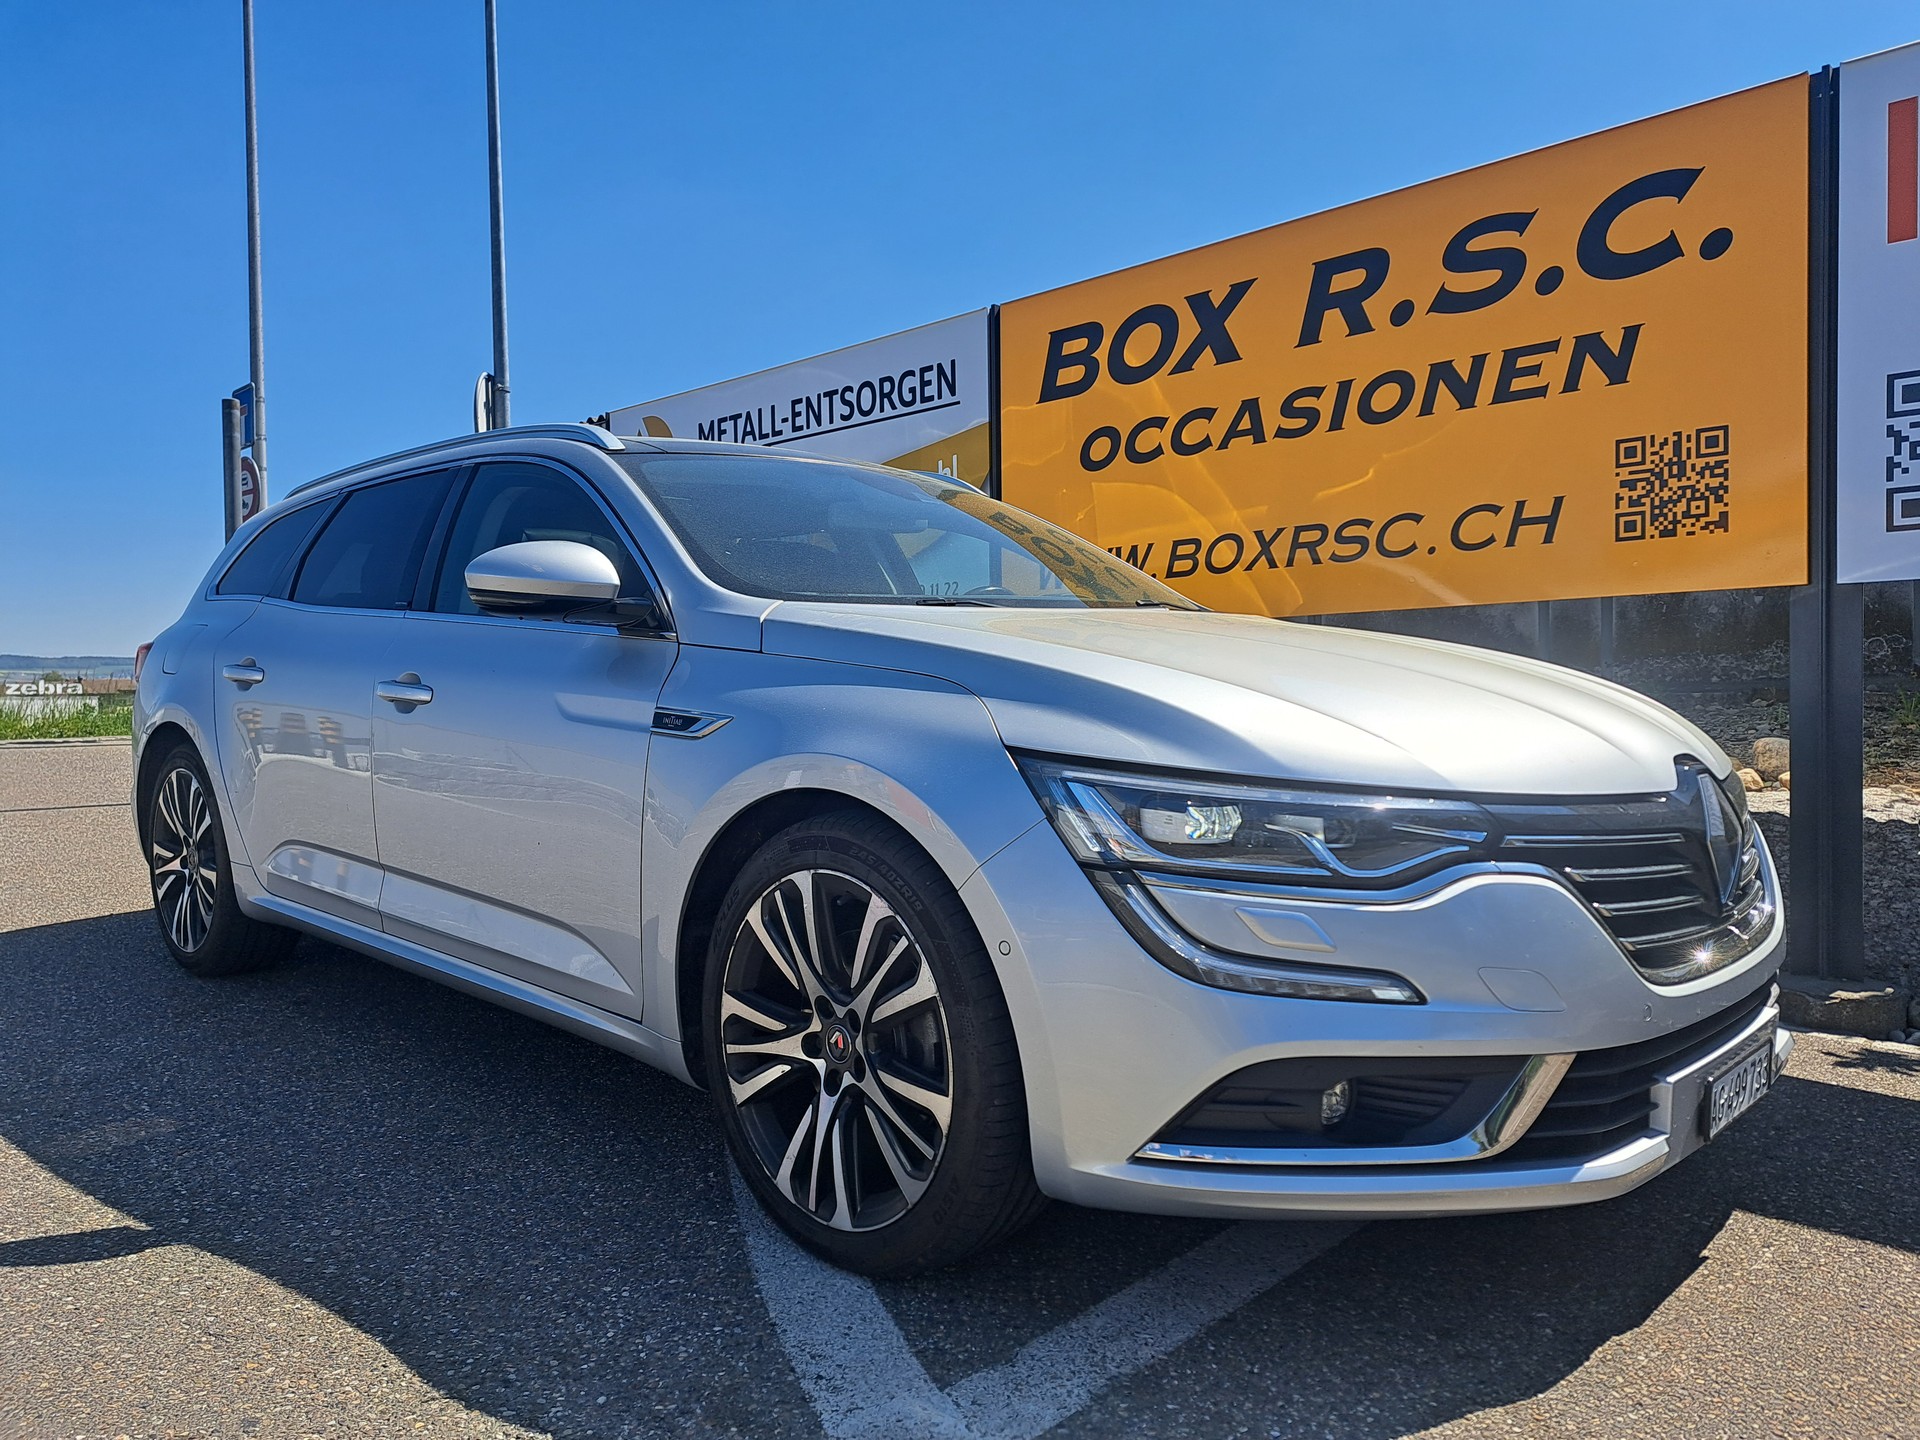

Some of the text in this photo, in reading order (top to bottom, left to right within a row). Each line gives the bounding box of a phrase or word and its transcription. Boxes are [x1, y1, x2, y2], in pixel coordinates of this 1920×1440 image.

[1035, 165, 1733, 405] BOX R.S.C.
[697, 358, 957, 444] METALL-ENTSORGEN
[1079, 323, 1646, 472] OCCASIONEN
[1106, 494, 1567, 581] W.BOXRSC.CH
[5, 680, 83, 695] zebra
